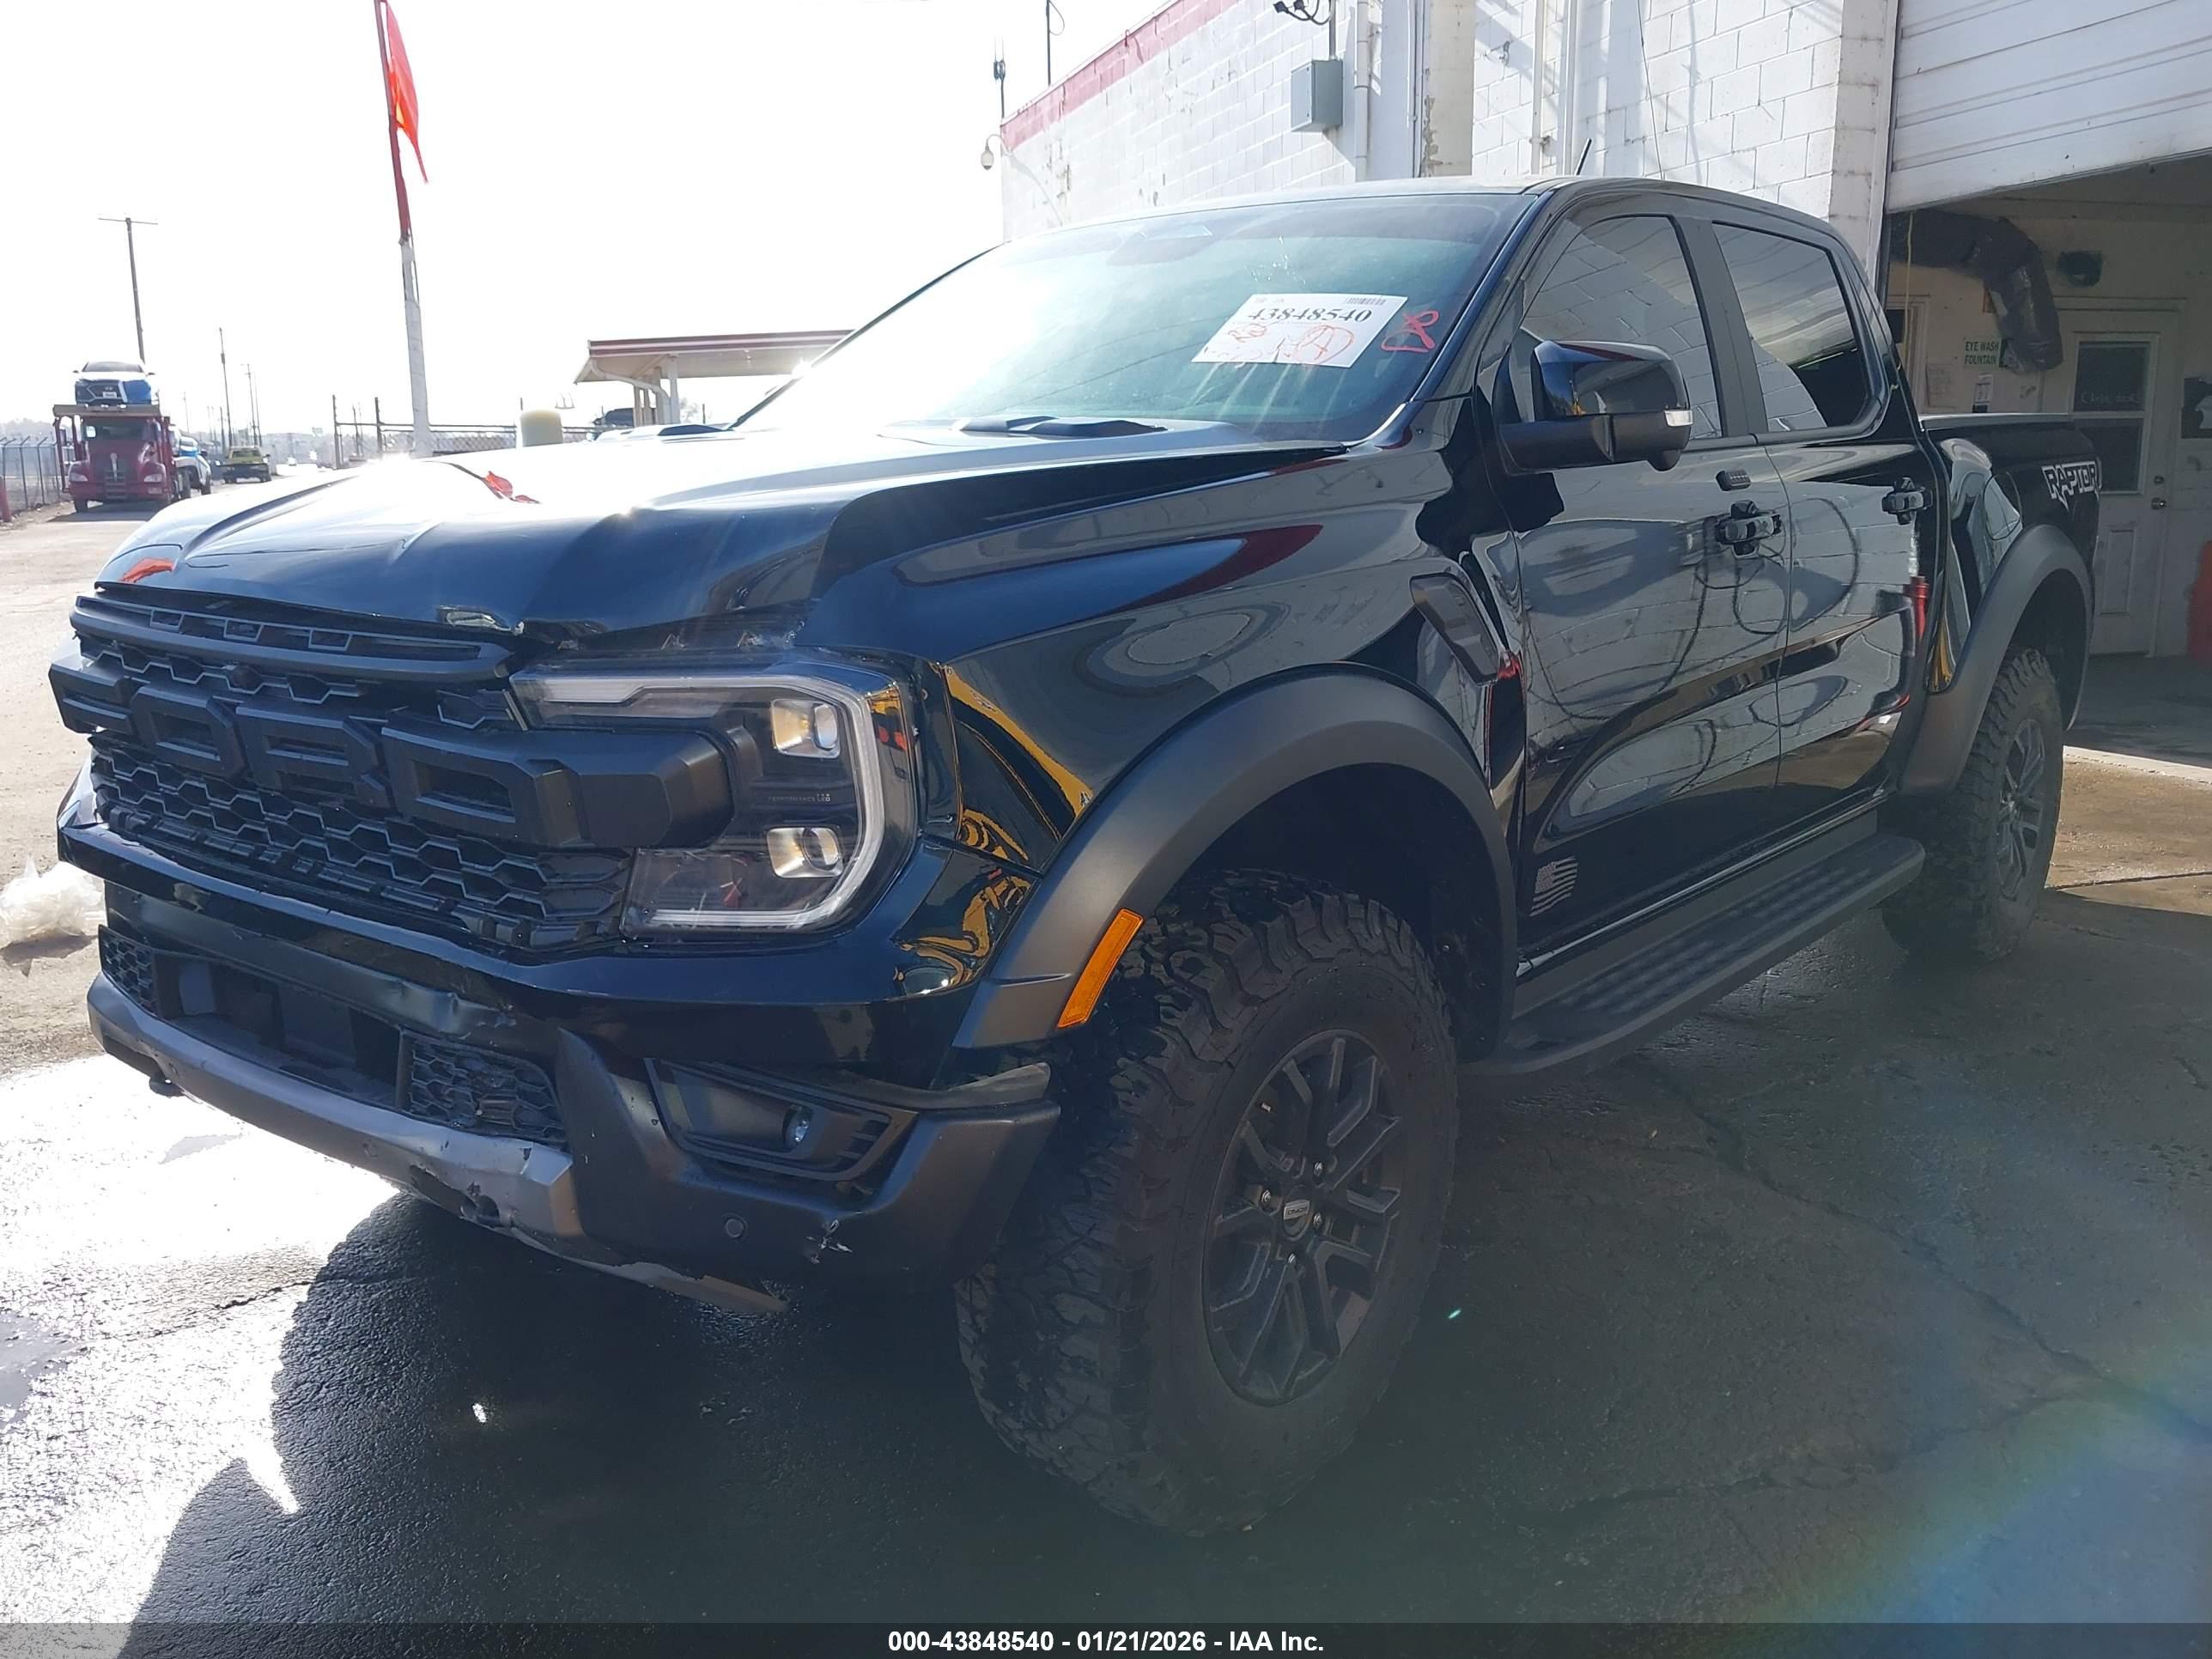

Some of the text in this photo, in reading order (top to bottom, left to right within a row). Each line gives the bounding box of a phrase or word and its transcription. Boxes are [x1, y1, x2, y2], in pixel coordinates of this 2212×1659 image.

[1248, 307, 1373, 322] 43848540
[1965, 341, 2000, 351] EYE WASH
[1964, 355, 1996, 365] FOUNTAIN
[2041, 460, 2100, 510] RAPTOR
